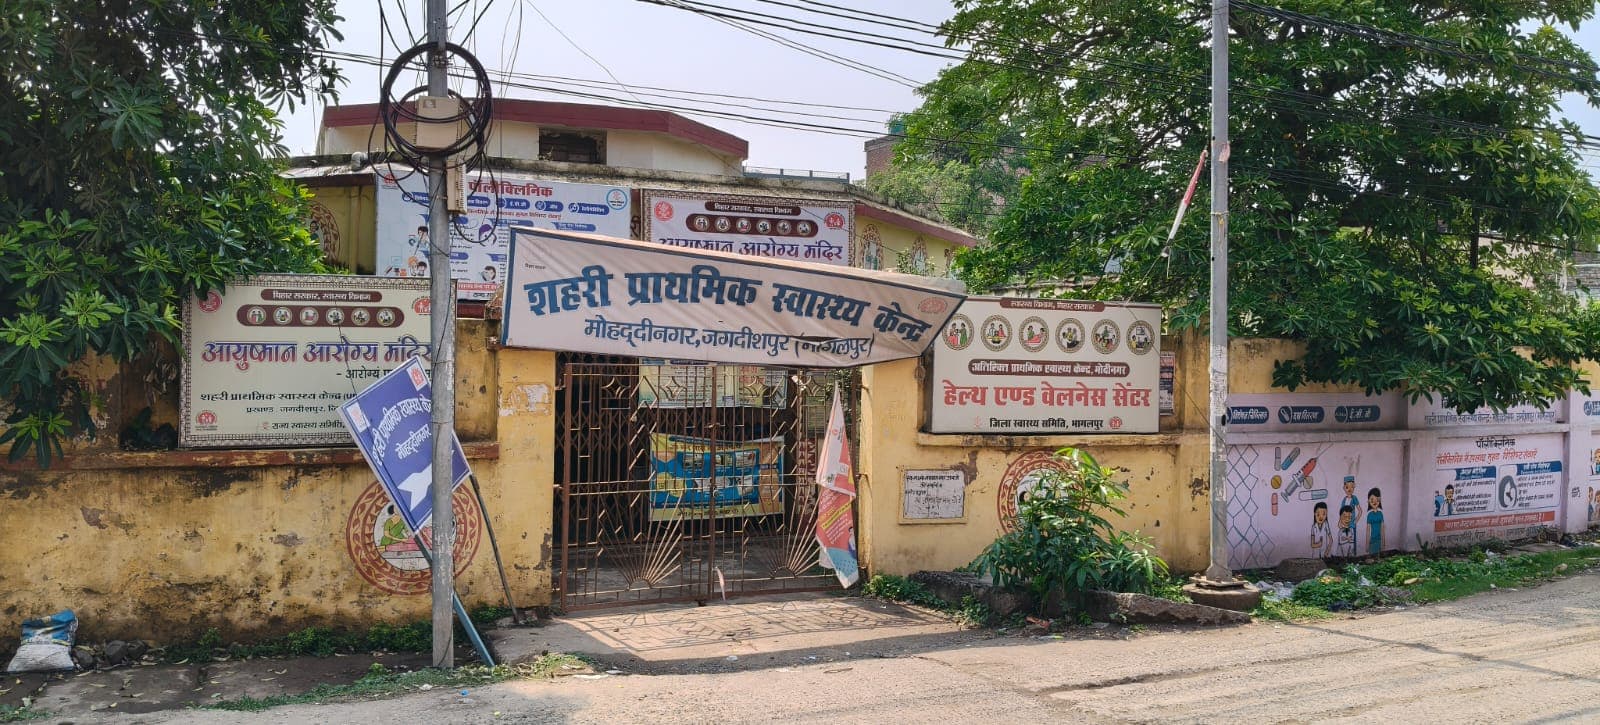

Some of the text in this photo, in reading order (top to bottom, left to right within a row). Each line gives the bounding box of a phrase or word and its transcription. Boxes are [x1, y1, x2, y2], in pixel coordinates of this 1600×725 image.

[468, 180, 554, 198] पॉलीक्लिनिक
[740, 238, 799, 257] आरोग्य
[804, 239, 844, 260] मंदिर
[524, 264, 614, 317] शहरी
[624, 264, 762, 314] प्राथमिक
[772, 282, 872, 328] स्वास्थ्य
[874, 302, 933, 342] केन्द्र
[202, 341, 298, 371] आयुष्मान
[303, 336, 380, 363] आरोग्य
[346, 366, 380, 379] आरोग्यं
[972, 361, 1009, 374] अतिरिक्त
[1011, 362, 1043, 374] प्राथमिक
[200, 390, 228, 402] शहरी
[230, 390, 276, 401] प्राथमिक
[278, 392, 316, 402] स्वास्थ्य
[942, 379, 989, 406] हेल्थ
[993, 384, 1036, 406] एण्ड
[1040, 380, 1108, 406] वेलनेस
[1112, 382, 1152, 407] सेंटर
[989, 416, 1104, 430] जिला स्वास्थ्य समिति, भागलपुर
